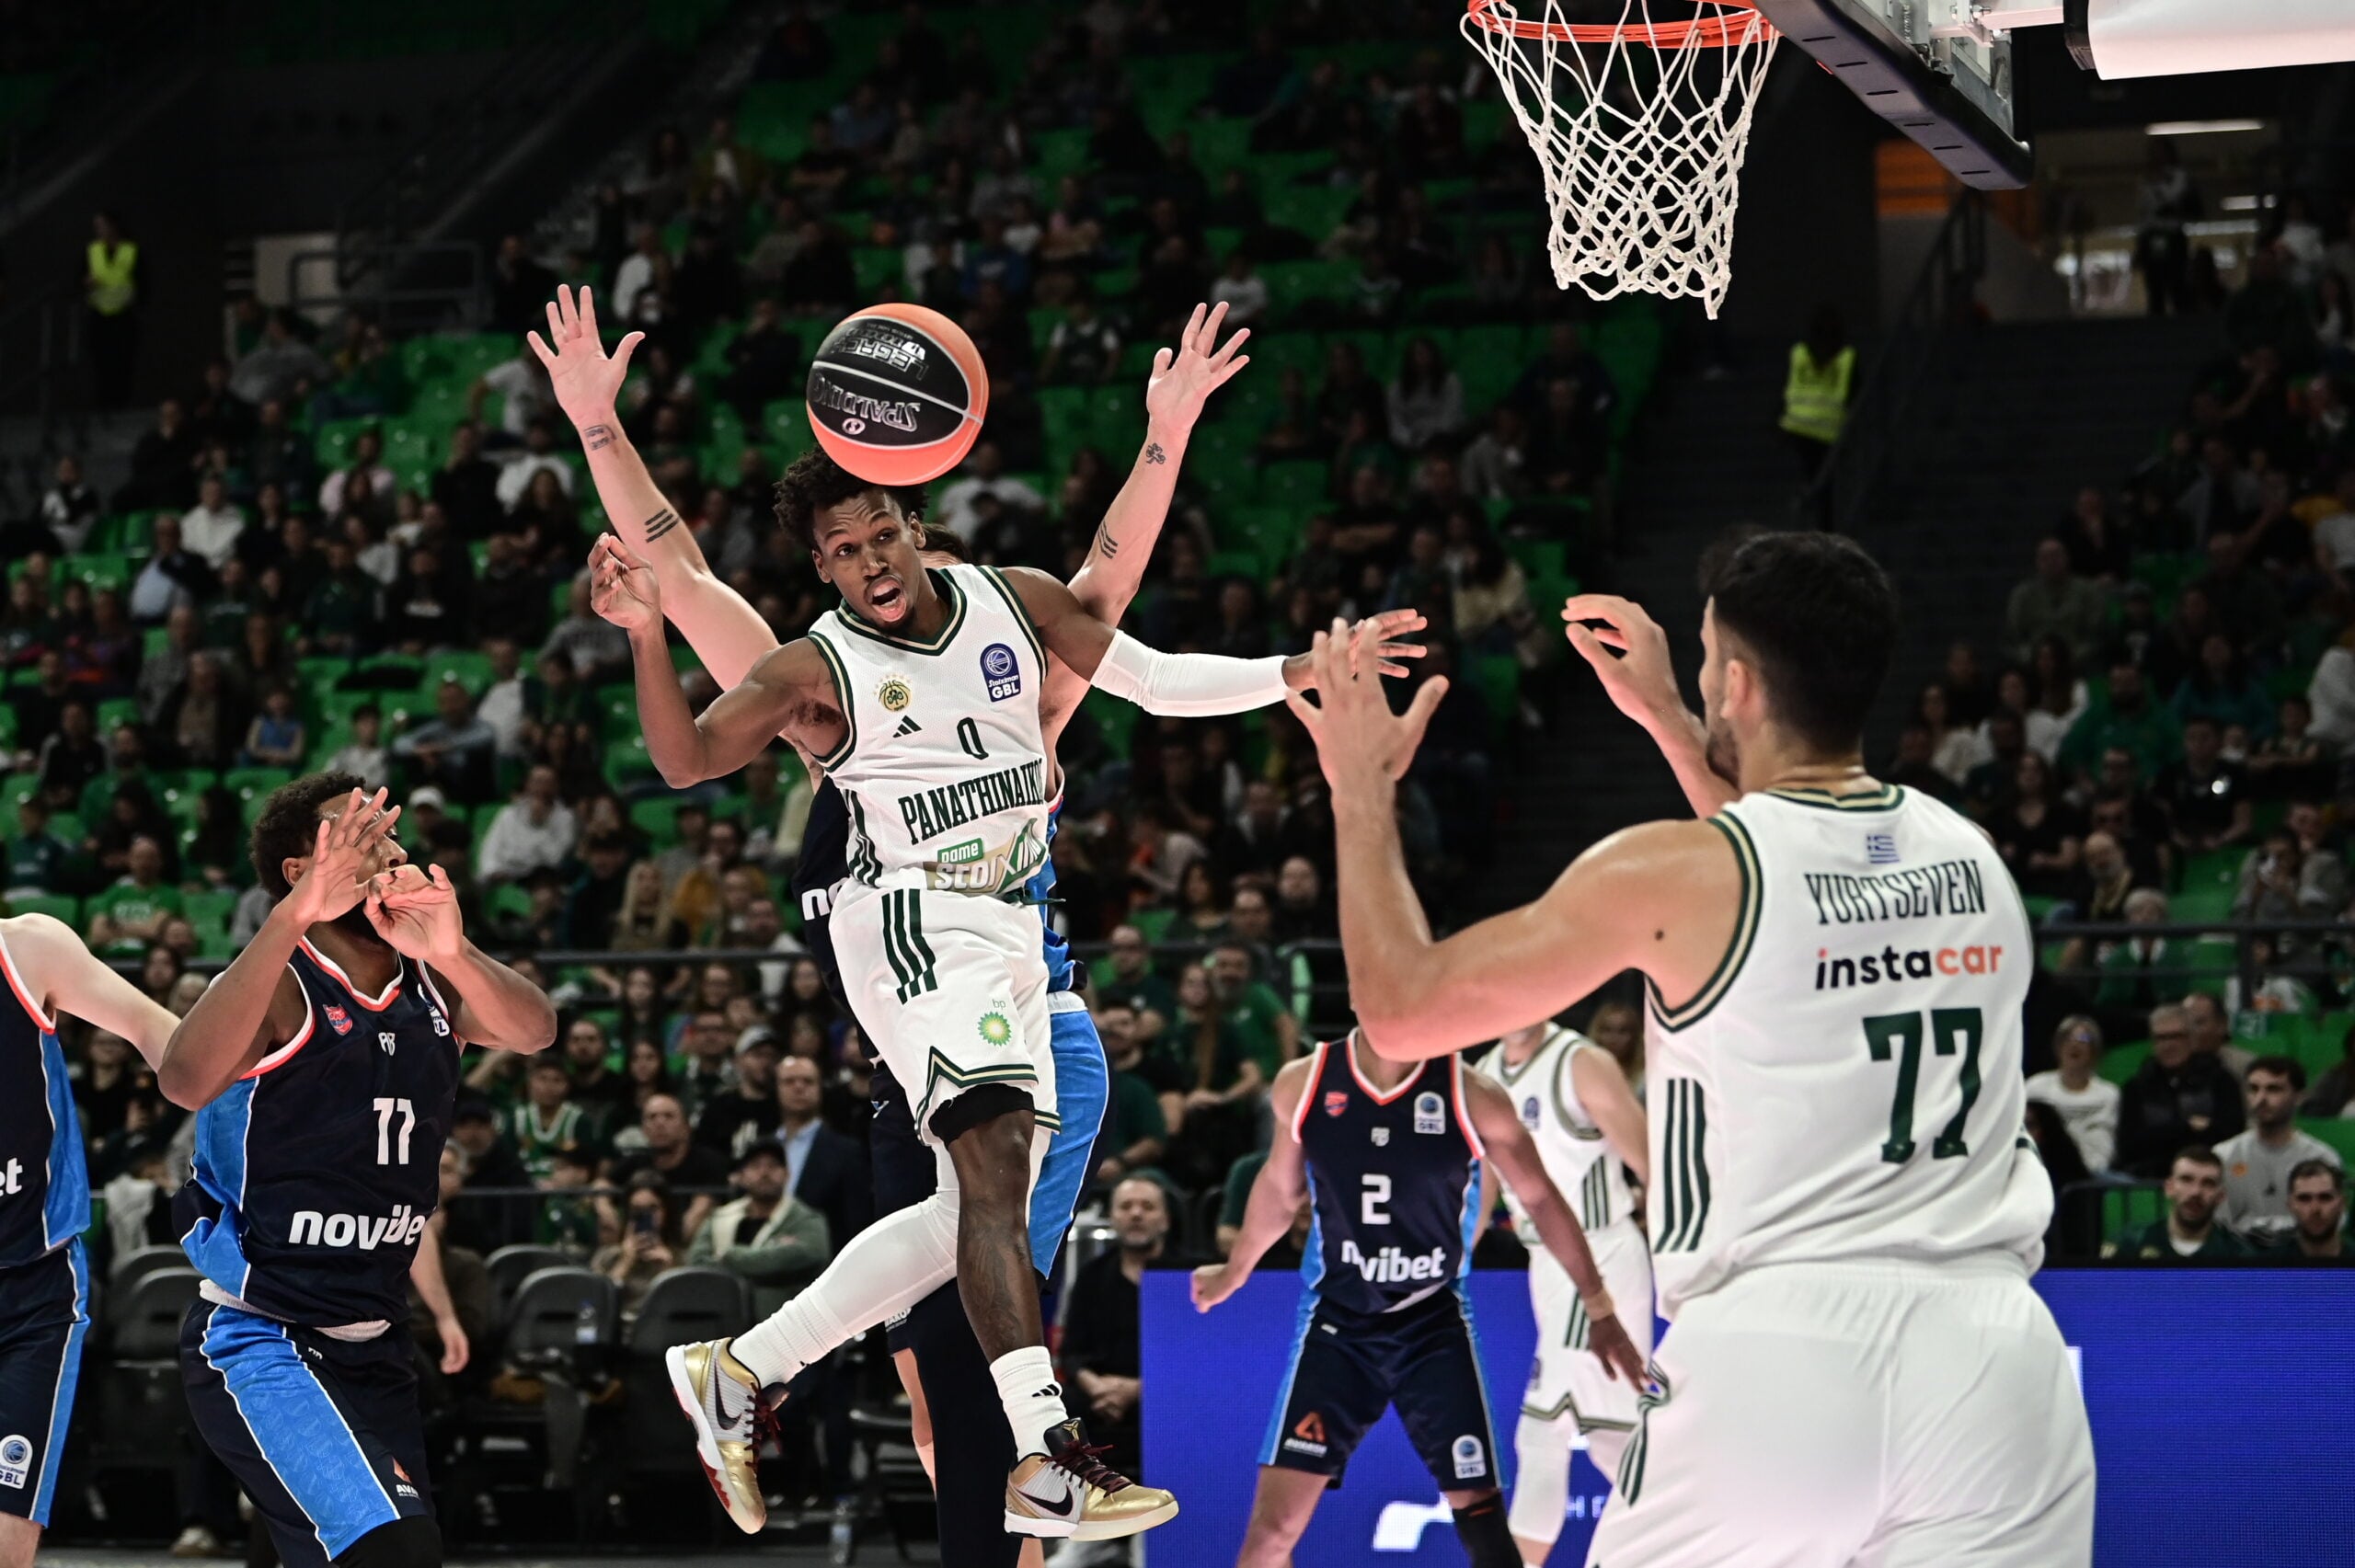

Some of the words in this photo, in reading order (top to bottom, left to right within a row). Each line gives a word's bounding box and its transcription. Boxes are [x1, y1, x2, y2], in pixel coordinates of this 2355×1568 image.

[830, 335, 930, 382] LEGACY
[813, 372, 921, 432] SPALDING
[988, 675, 1019, 688] Stoiximan
[992, 682, 1019, 699] GBL
[957, 716, 989, 761] 0
[1804, 859, 1987, 926] YURTSEVEN
[1815, 944, 2005, 991] instacar
[992, 999, 1006, 1010] bp
[1862, 1007, 1983, 1163] 77
[1361, 1173, 1392, 1226] 2
